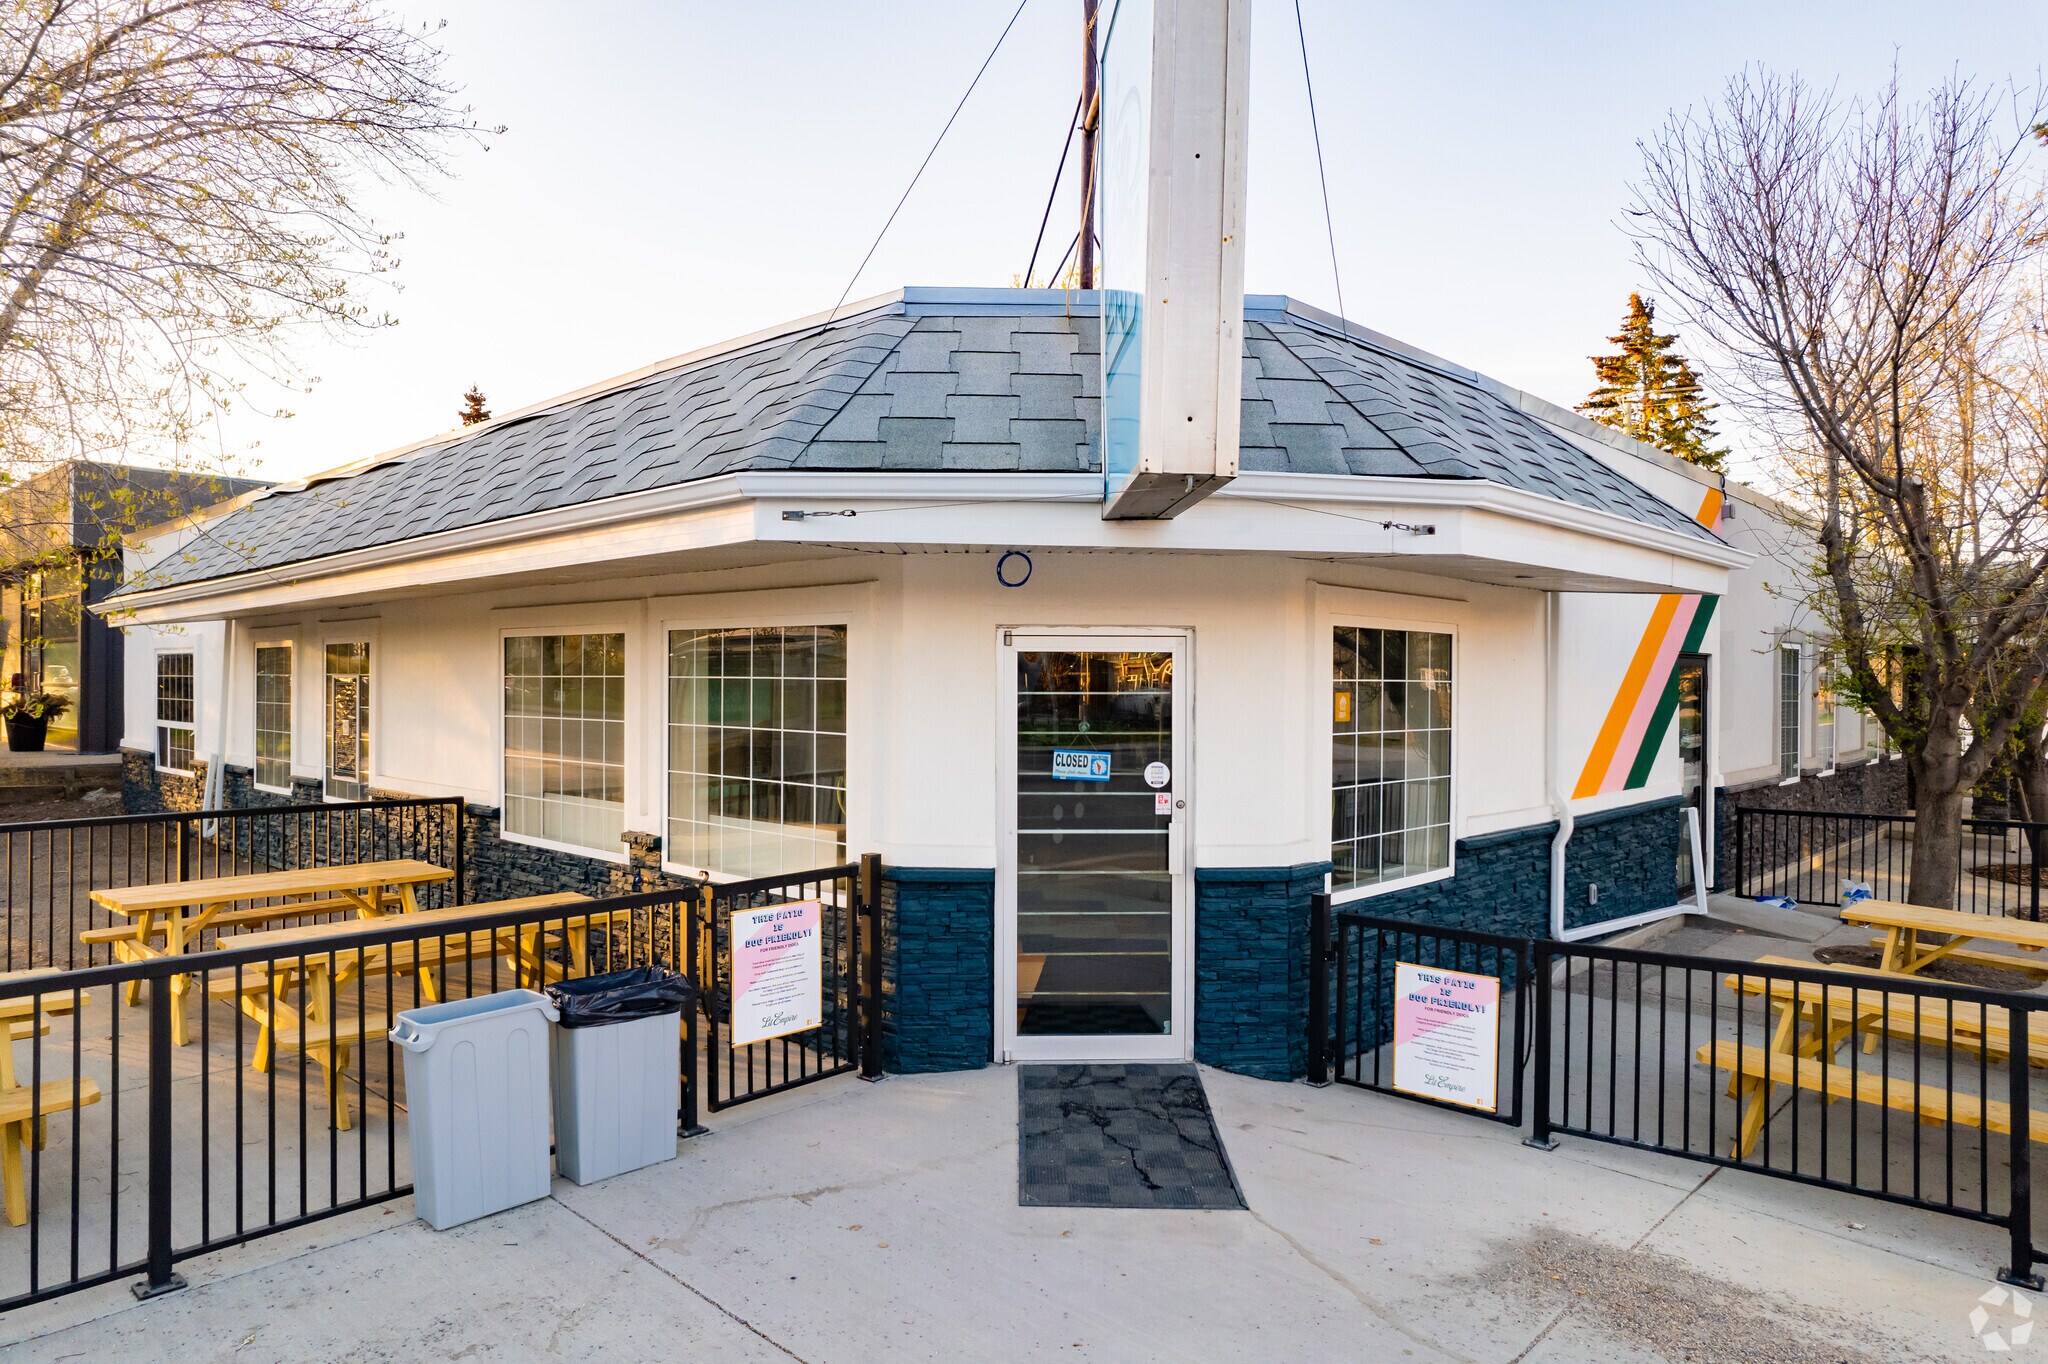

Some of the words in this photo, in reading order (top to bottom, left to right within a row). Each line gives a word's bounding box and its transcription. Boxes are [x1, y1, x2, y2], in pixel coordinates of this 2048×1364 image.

[1056, 753, 1088, 768] CLOSED
[752, 913, 774, 924] THIS
[777, 909, 803, 920] PATIO
[774, 924, 784, 932] IS
[745, 938, 763, 948] DOG
[766, 928, 812, 944] FRIENDLY!
[1418, 973, 1441, 984] THIS
[1444, 977, 1476, 990] PATIO
[1440, 988, 1452, 996] IS
[1408, 993, 1428, 1003] DOG
[1431, 996, 1485, 1014] FRIENDLY!
[773, 1011, 798, 1025] Empire
[1437, 1076, 1466, 1092] Empire
